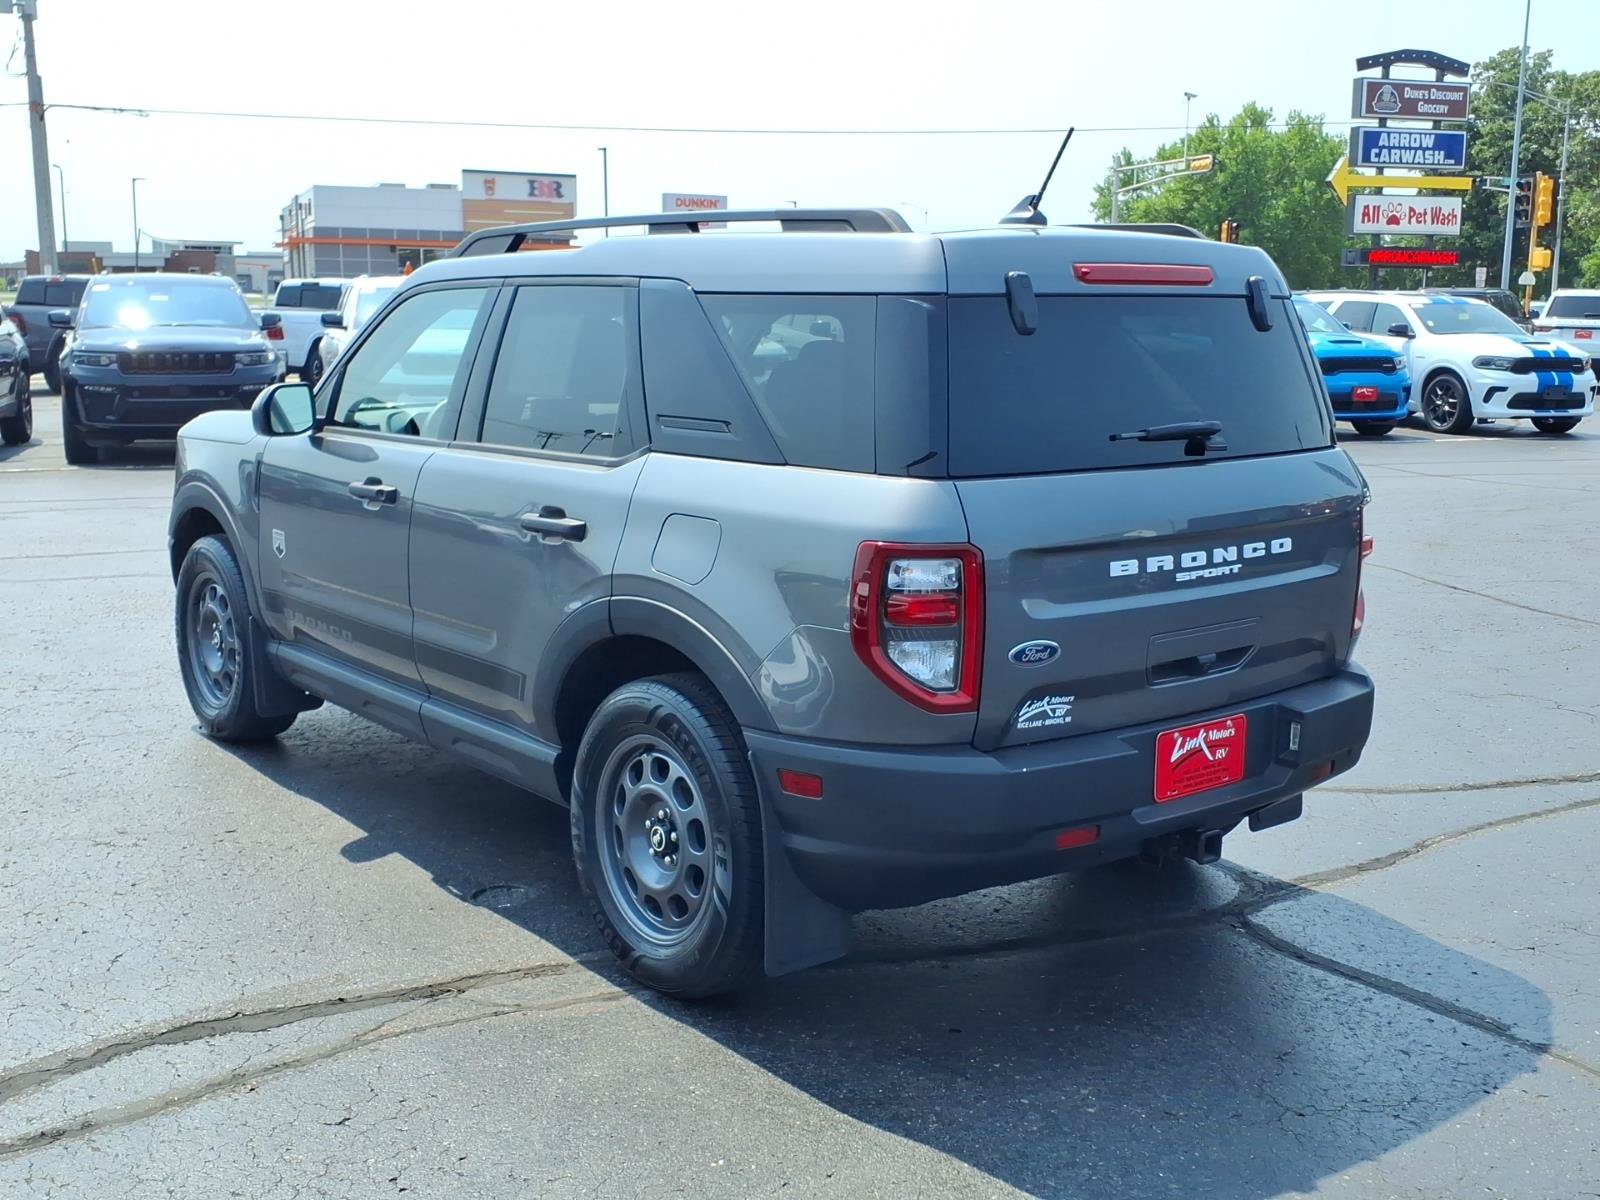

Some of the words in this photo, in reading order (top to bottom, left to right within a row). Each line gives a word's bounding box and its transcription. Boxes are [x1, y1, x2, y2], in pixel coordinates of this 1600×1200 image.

[1404, 87, 1429, 99] DUKE'S
[1430, 88, 1464, 101] DISCOUNT
[1417, 101, 1449, 114] GROCERY
[1378, 132, 1435, 148] ARROW
[1361, 204, 1381, 224] All
[1408, 206, 1428, 225] Pet
[1430, 206, 1458, 227] Wash
[1109, 537, 1293, 577] BRONCO
[1175, 563, 1243, 582] SPORT
[1022, 645, 1051, 662] Ford
[1018, 695, 1054, 717] Link
[1054, 708, 1067, 717] RV
[1170, 728, 1214, 763] Link
[1207, 728, 1236, 741] Motors
[1215, 747, 1229, 760] RV
